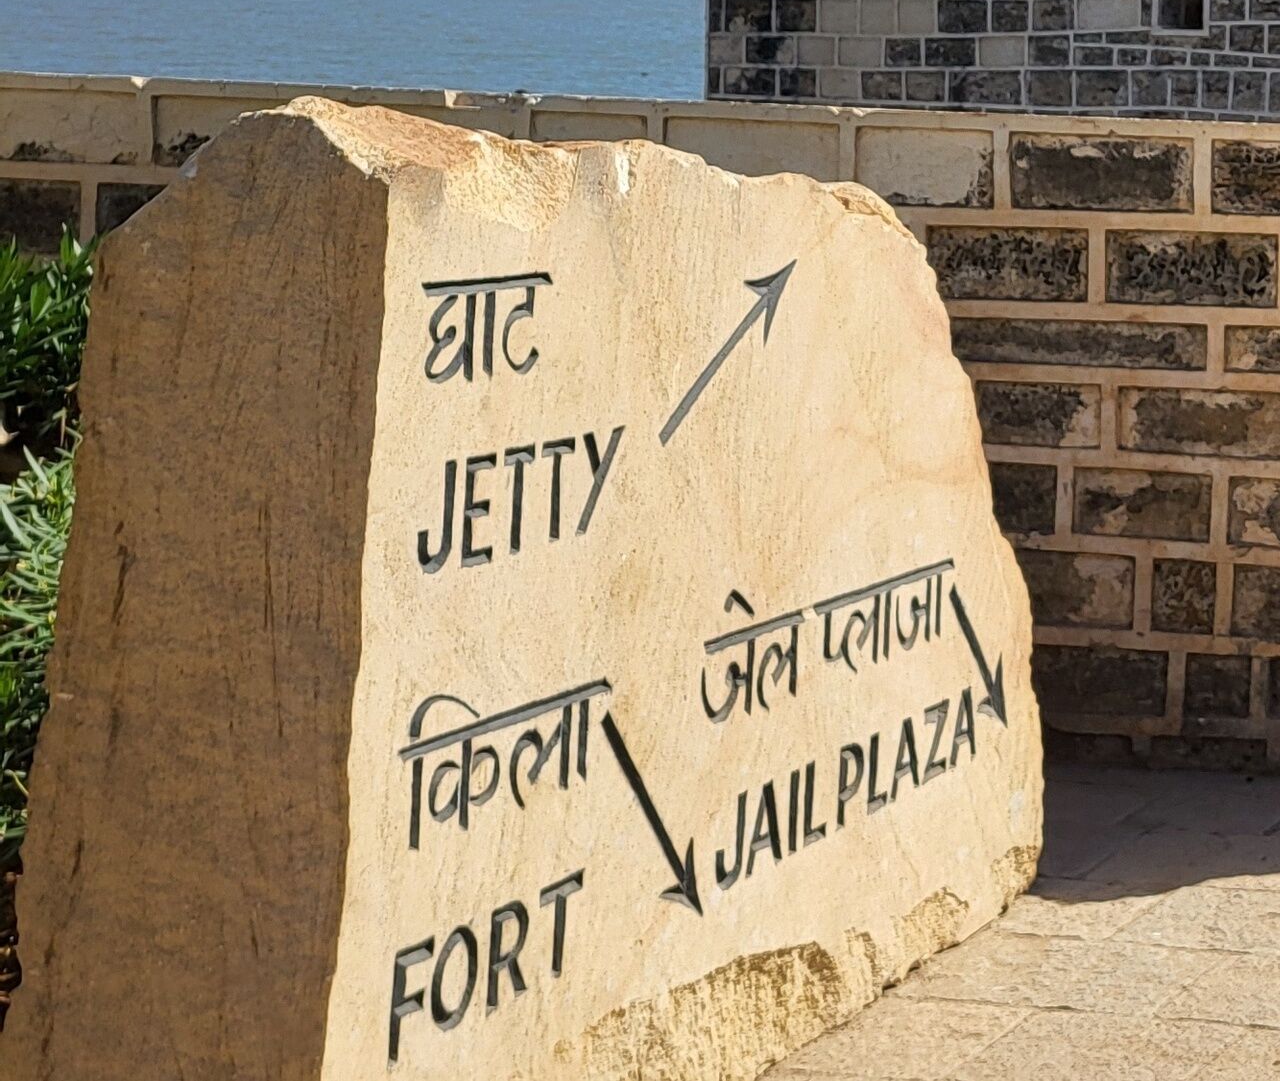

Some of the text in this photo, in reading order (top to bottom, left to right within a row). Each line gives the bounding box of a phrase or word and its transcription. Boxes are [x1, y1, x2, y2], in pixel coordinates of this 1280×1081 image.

[422, 271, 554, 381] घाट
[416, 426, 625, 573] JETTY
[702, 558, 955, 723] जेल प्लाजा
[399, 677, 612, 851] किला
[714, 686, 977, 890] JAIL PLAZA
[388, 868, 585, 1063] FORT
